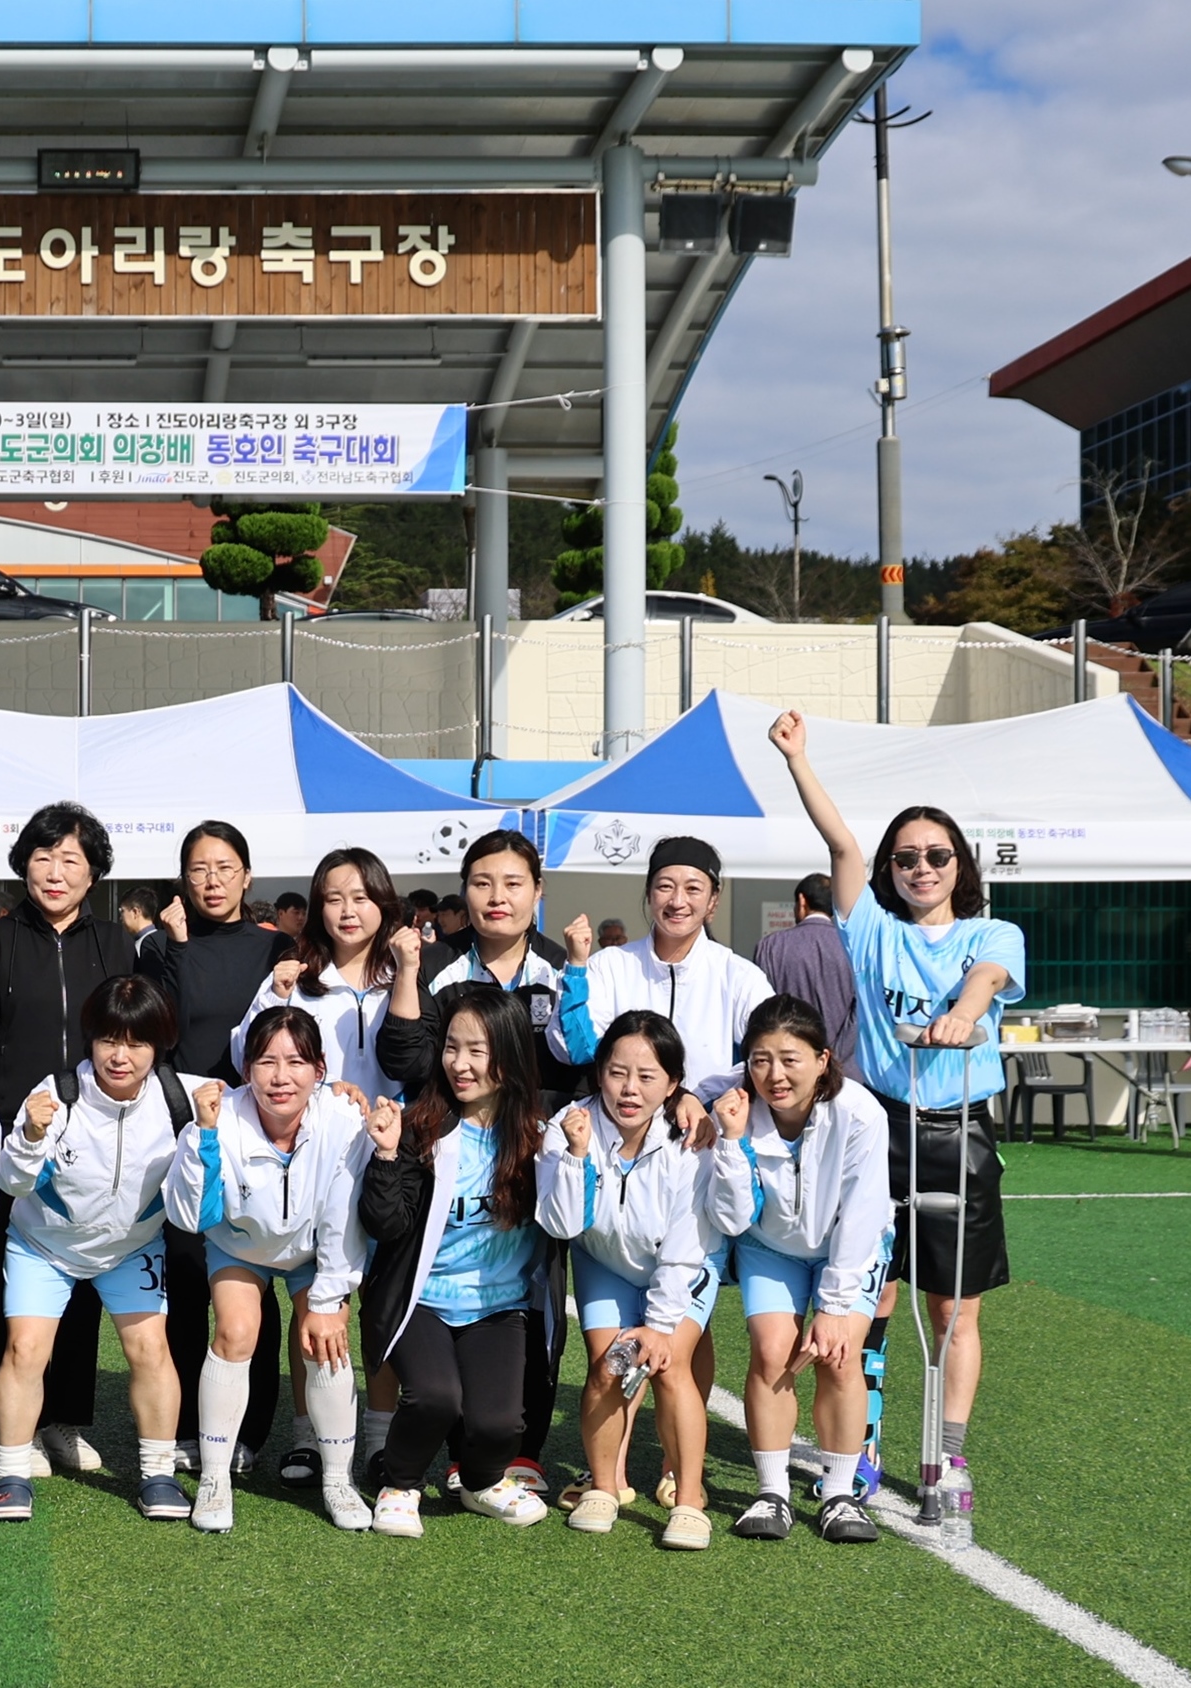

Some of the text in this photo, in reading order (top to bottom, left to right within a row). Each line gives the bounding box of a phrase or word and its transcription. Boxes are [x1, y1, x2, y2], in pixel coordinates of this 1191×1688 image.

[260, 221, 456, 287] 축구장
[106, 412, 141, 429] 장소
[156, 413, 288, 430] 진도아리랑축구장
[294, 413, 309, 429] 외
[315, 413, 358, 430] 3구장
[112, 431, 193, 465] 의장배
[206, 432, 285, 466] 동호인
[292, 432, 398, 466] 축구대회
[98, 469, 125, 485] 후원
[315, 470, 415, 485] 전라남도축구협회
[135, 822, 175, 834] 축구대회
[1017, 827, 1047, 839] 동호인
[1047, 828, 1087, 839] 축구대회
